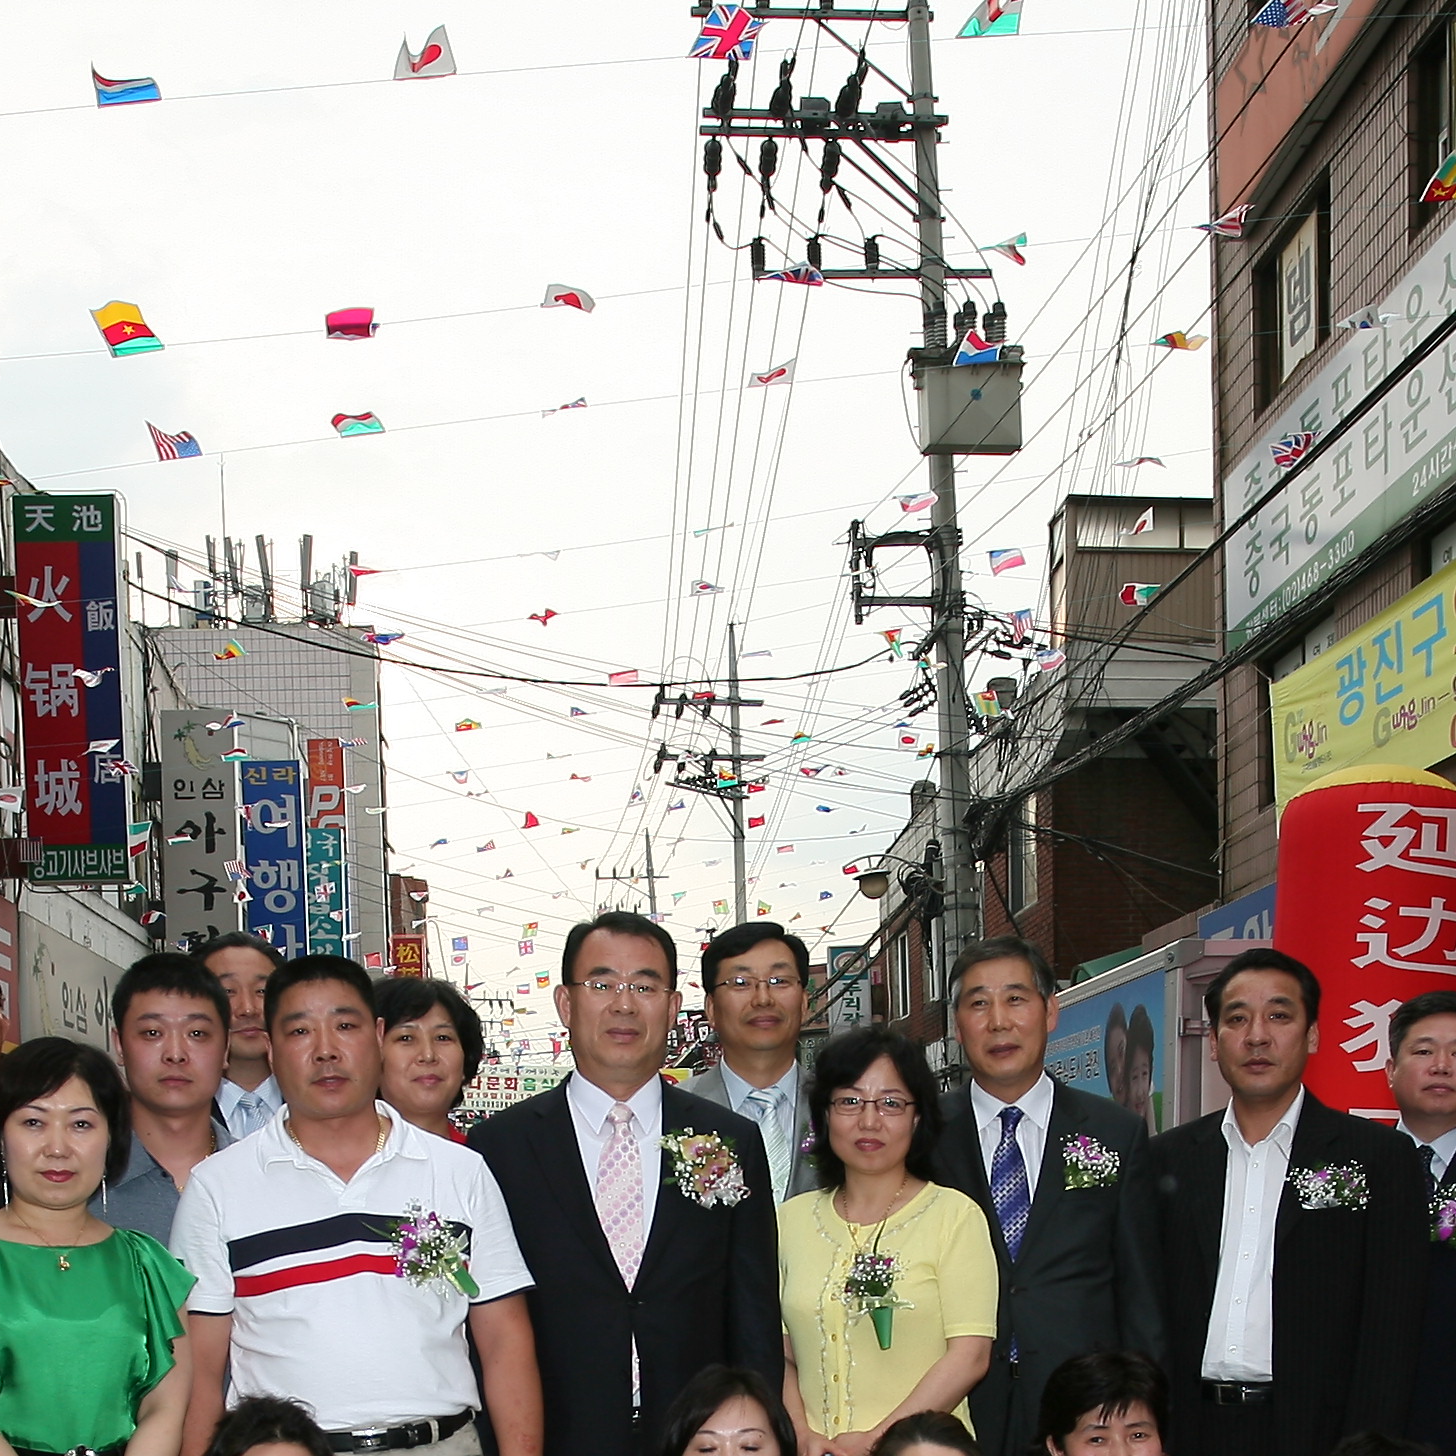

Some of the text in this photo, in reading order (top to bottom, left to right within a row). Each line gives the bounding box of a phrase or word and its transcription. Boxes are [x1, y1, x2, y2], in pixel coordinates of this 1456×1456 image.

[24, 504, 103, 533] 天池
[244, 766, 297, 785] 신라
[173, 777, 225, 800] 인삼
